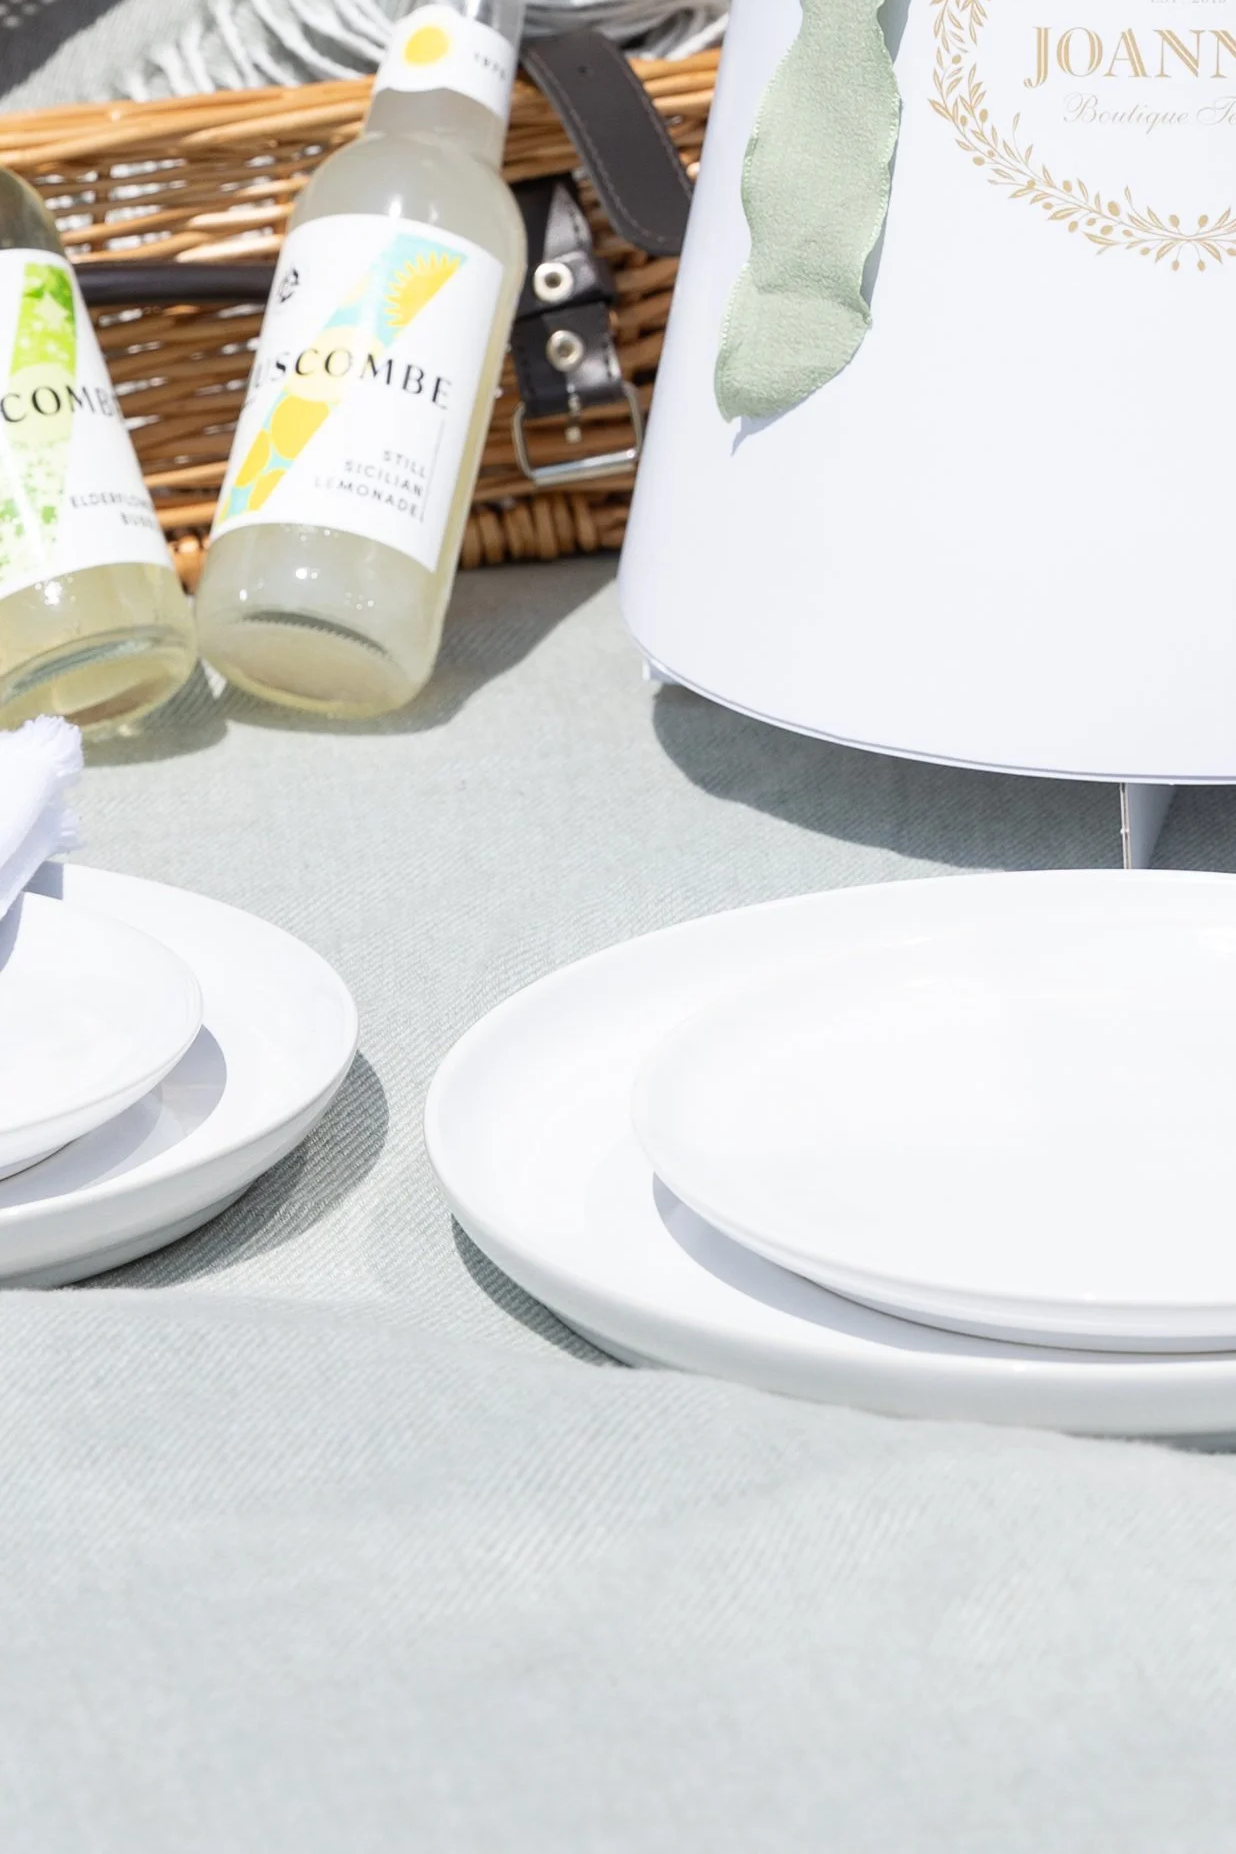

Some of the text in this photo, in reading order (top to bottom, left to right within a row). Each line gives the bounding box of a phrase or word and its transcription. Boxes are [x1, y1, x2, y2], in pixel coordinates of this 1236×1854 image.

[1063, 92, 1189, 135] Boutique
[344, 459, 423, 498] SICILIAN
[383, 449, 426, 480] STILL
[314, 474, 418, 519] LEMONADE
